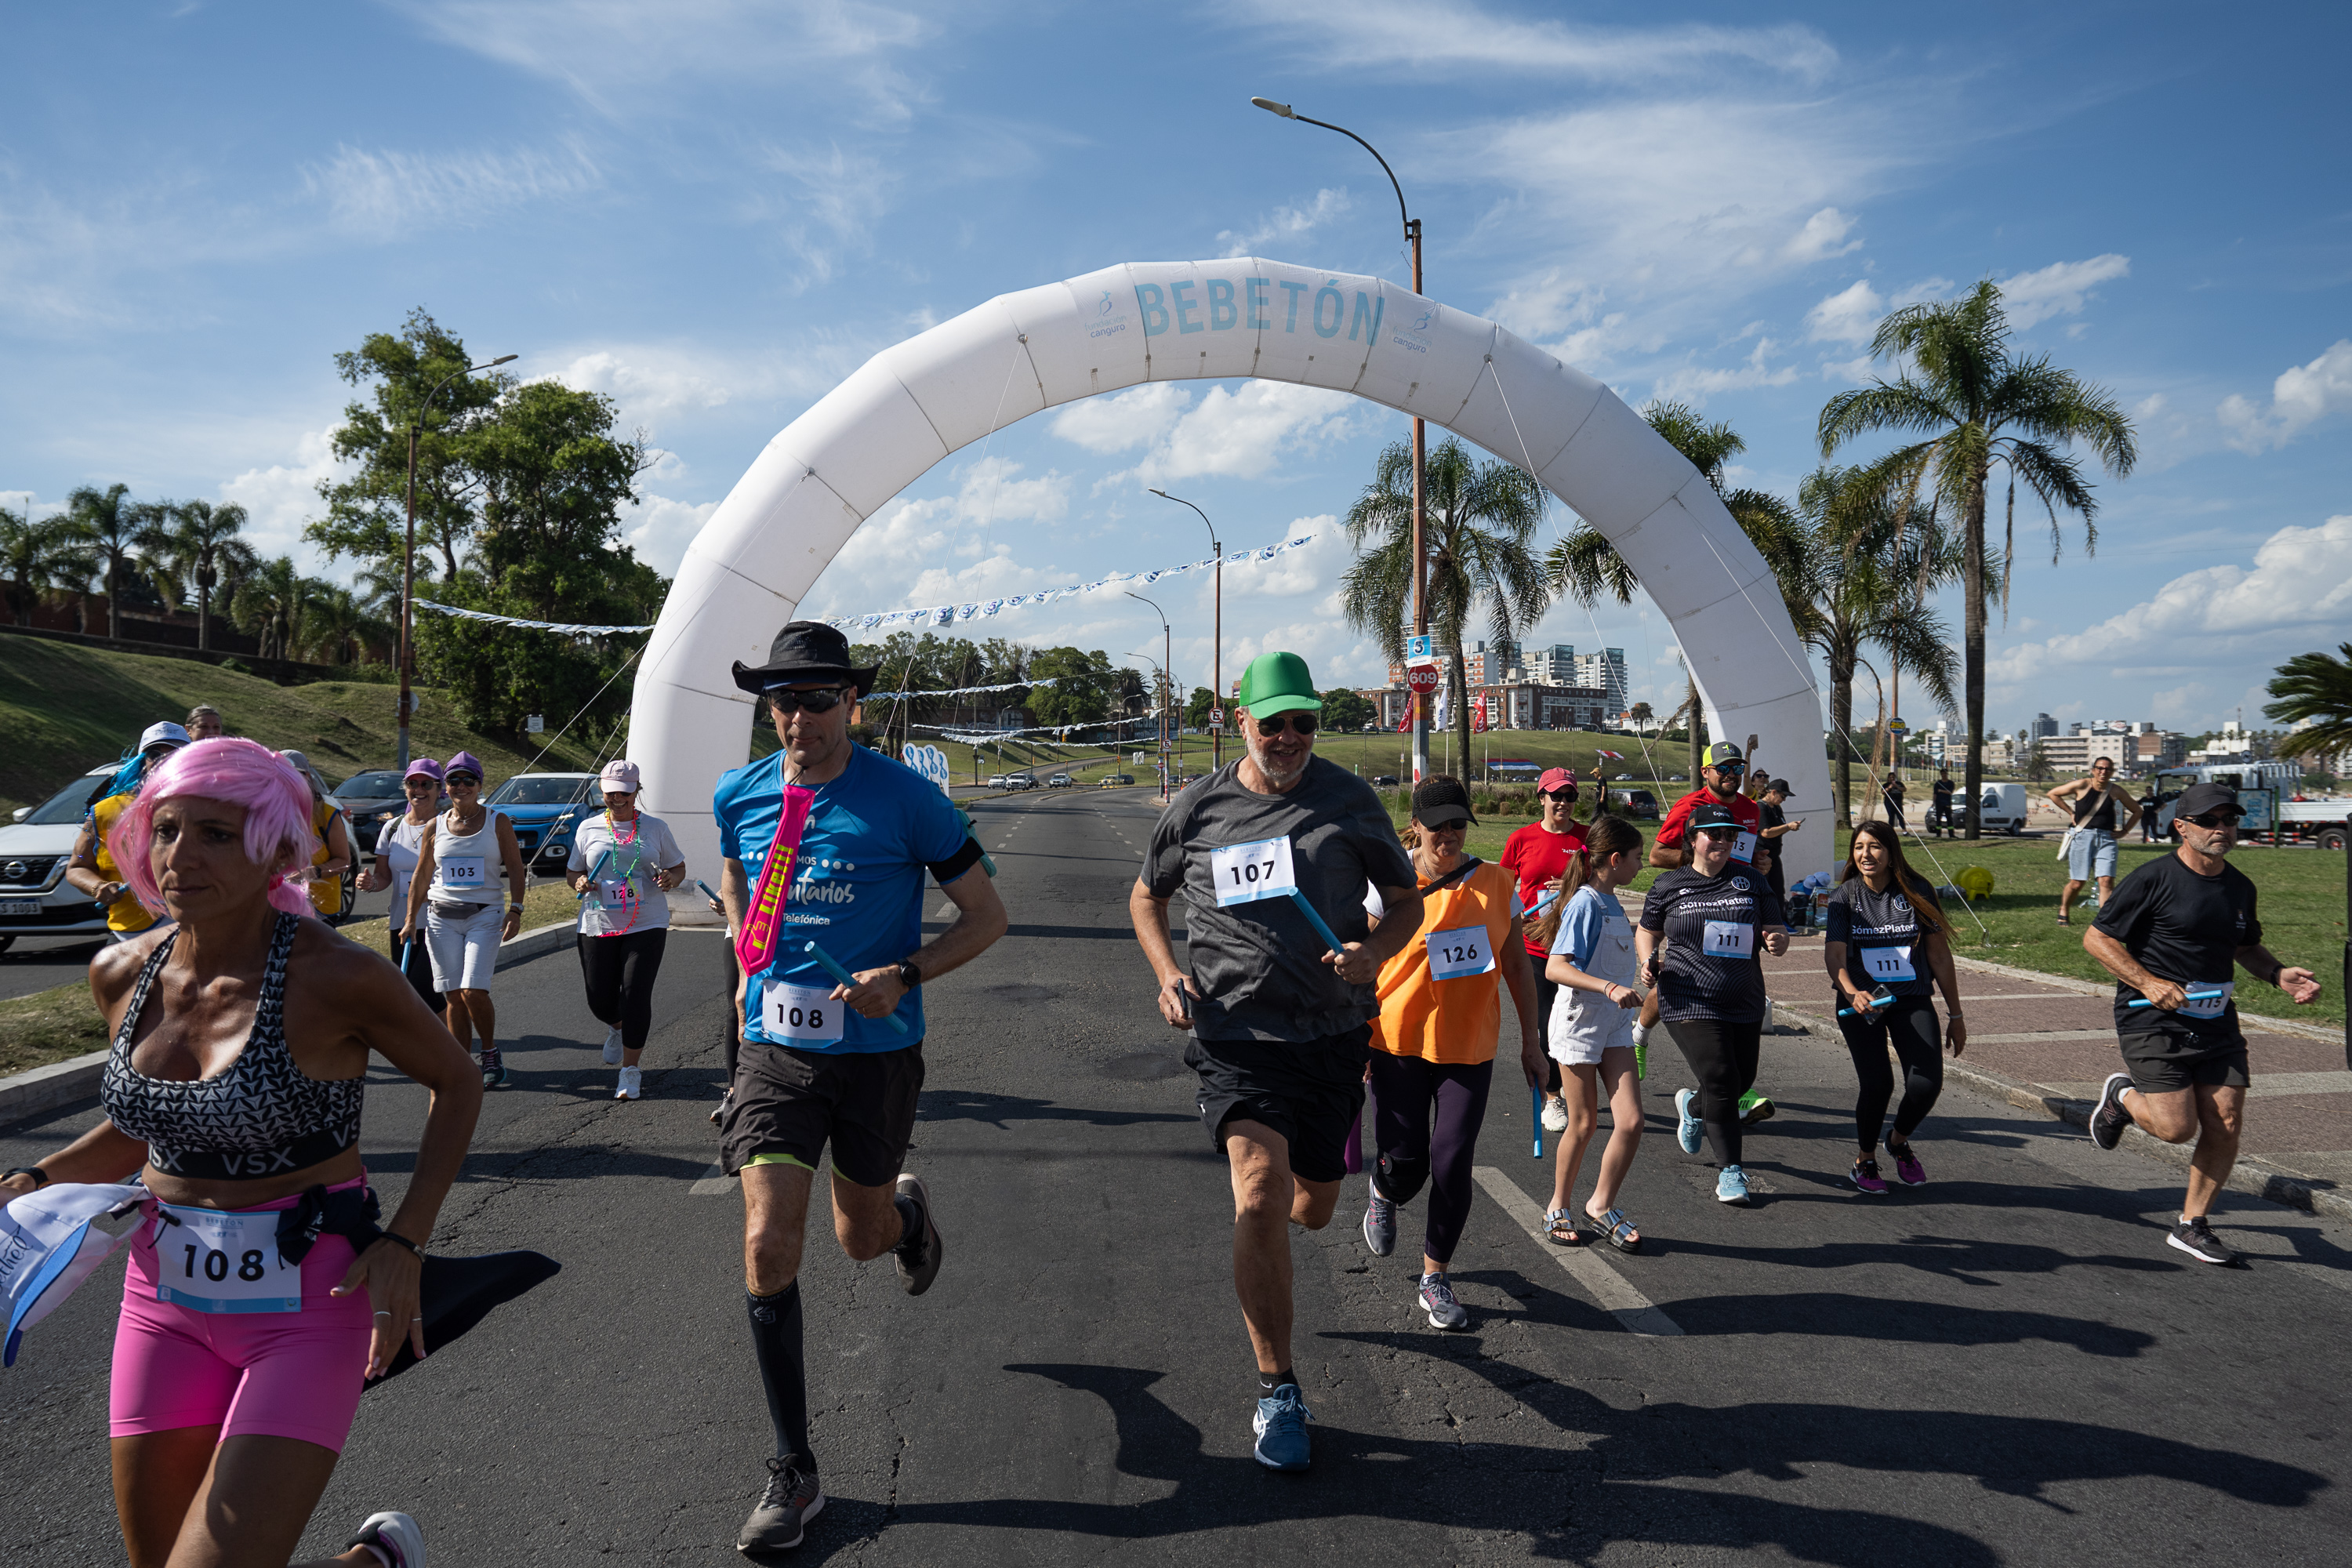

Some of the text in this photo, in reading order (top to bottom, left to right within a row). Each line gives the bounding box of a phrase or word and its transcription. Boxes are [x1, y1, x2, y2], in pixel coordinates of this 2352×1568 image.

[1134, 278, 1385, 347] BEBETÓN
[1084, 314, 1127, 332] fundación
[1090, 324, 1126, 338] canguro
[1393, 326, 1432, 347] fundación
[1393, 336, 1426, 353] canguro
[1413, 639, 1425, 655] 5
[1409, 672, 1437, 684] 609
[1733, 840, 1746, 851] 13
[796, 855, 816, 866] MOS
[451, 867, 475, 877] 103
[1231, 860, 1275, 885] 107
[612, 888, 634, 899] 128
[782, 913, 830, 926] Telefónica
[1719, 934, 1739, 947] 111
[1443, 944, 1477, 964] 126
[1877, 960, 1899, 971] 111
[777, 1004, 823, 1029] 108
[148, 1143, 184, 1172] SX
[222, 1146, 296, 1175] VSX
[184, 1243, 265, 1282] 108
